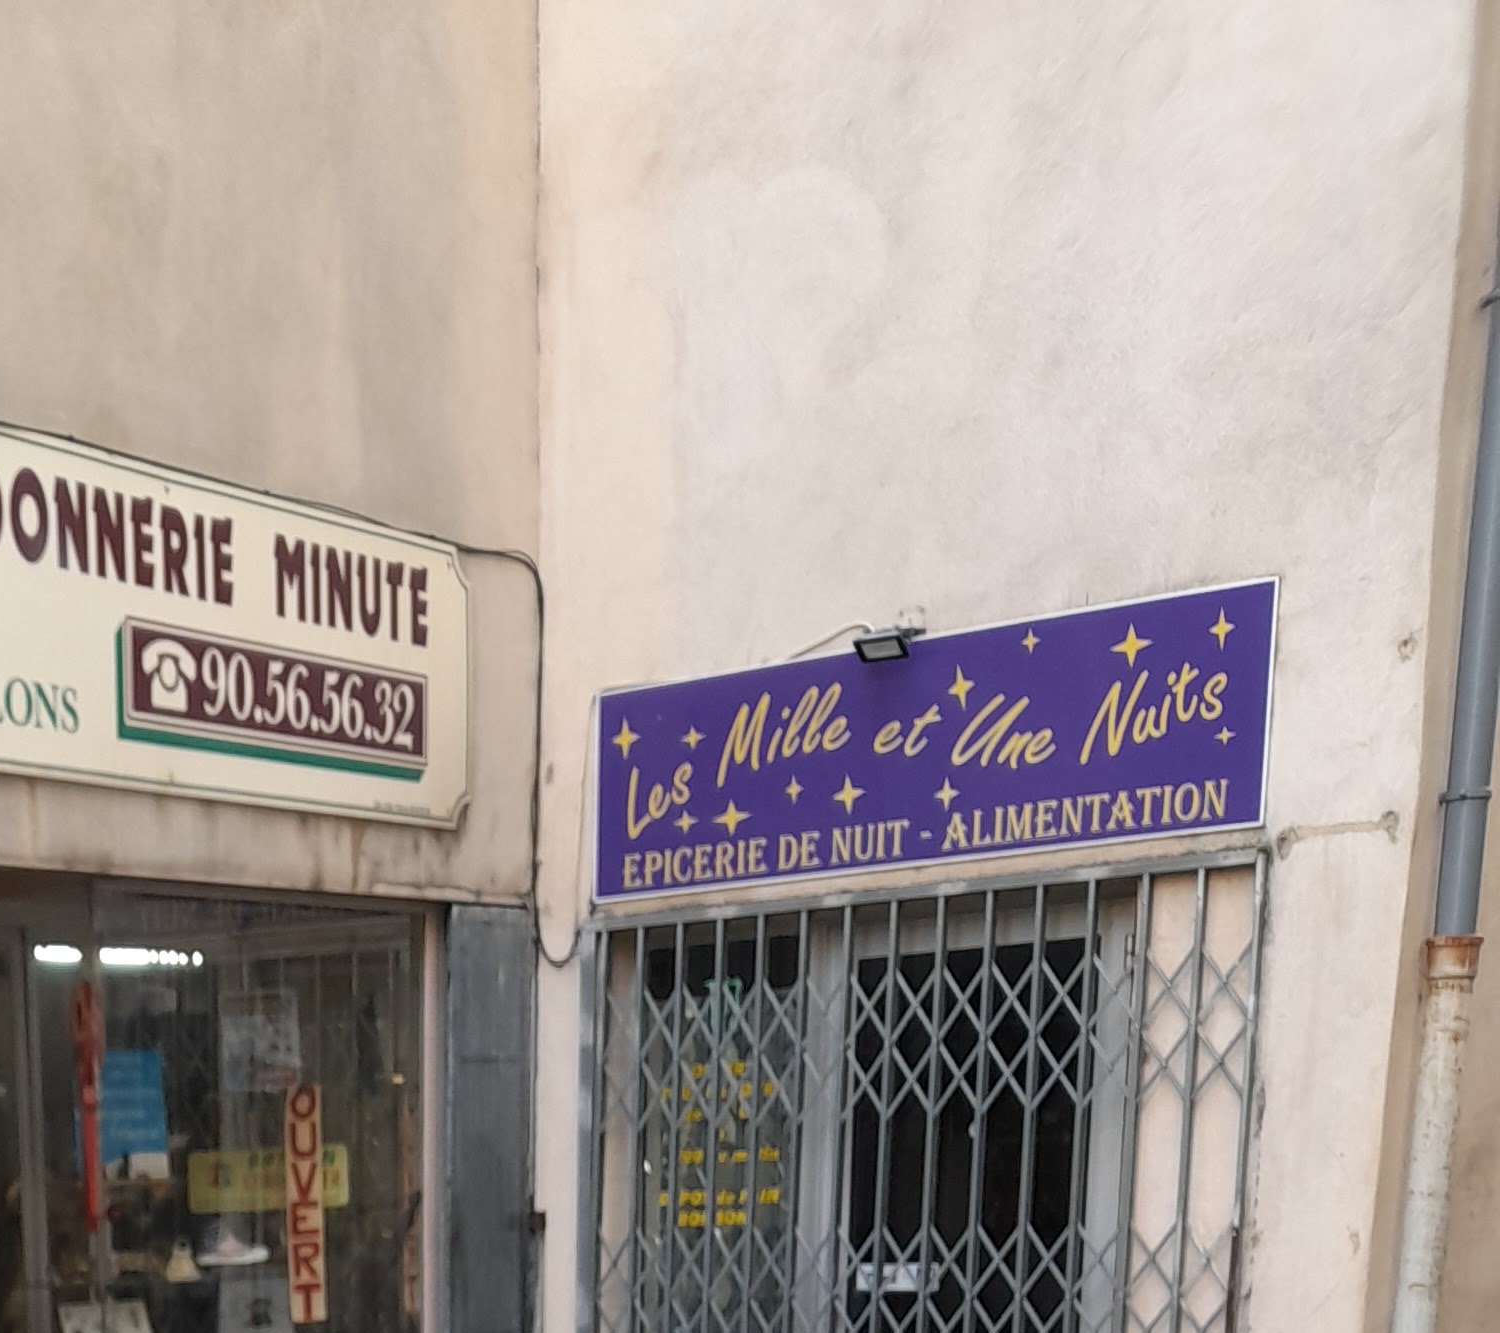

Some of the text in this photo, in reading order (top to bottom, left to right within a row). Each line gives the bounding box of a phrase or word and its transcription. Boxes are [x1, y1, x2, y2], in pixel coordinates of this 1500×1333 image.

[274, 532, 429, 648] MINUTE
[202, 645, 416, 751] 90.56.56.32
[627, 661, 1229, 840] Les Mille et Une Nuits
[622, 837, 767, 890] EPICERIE
[778, 830, 819, 871] DE
[830, 819, 909, 864] NUIT
[941, 778, 1230, 851] ALIMENTATION
[290, 1086, 324, 1322] OUVERT
